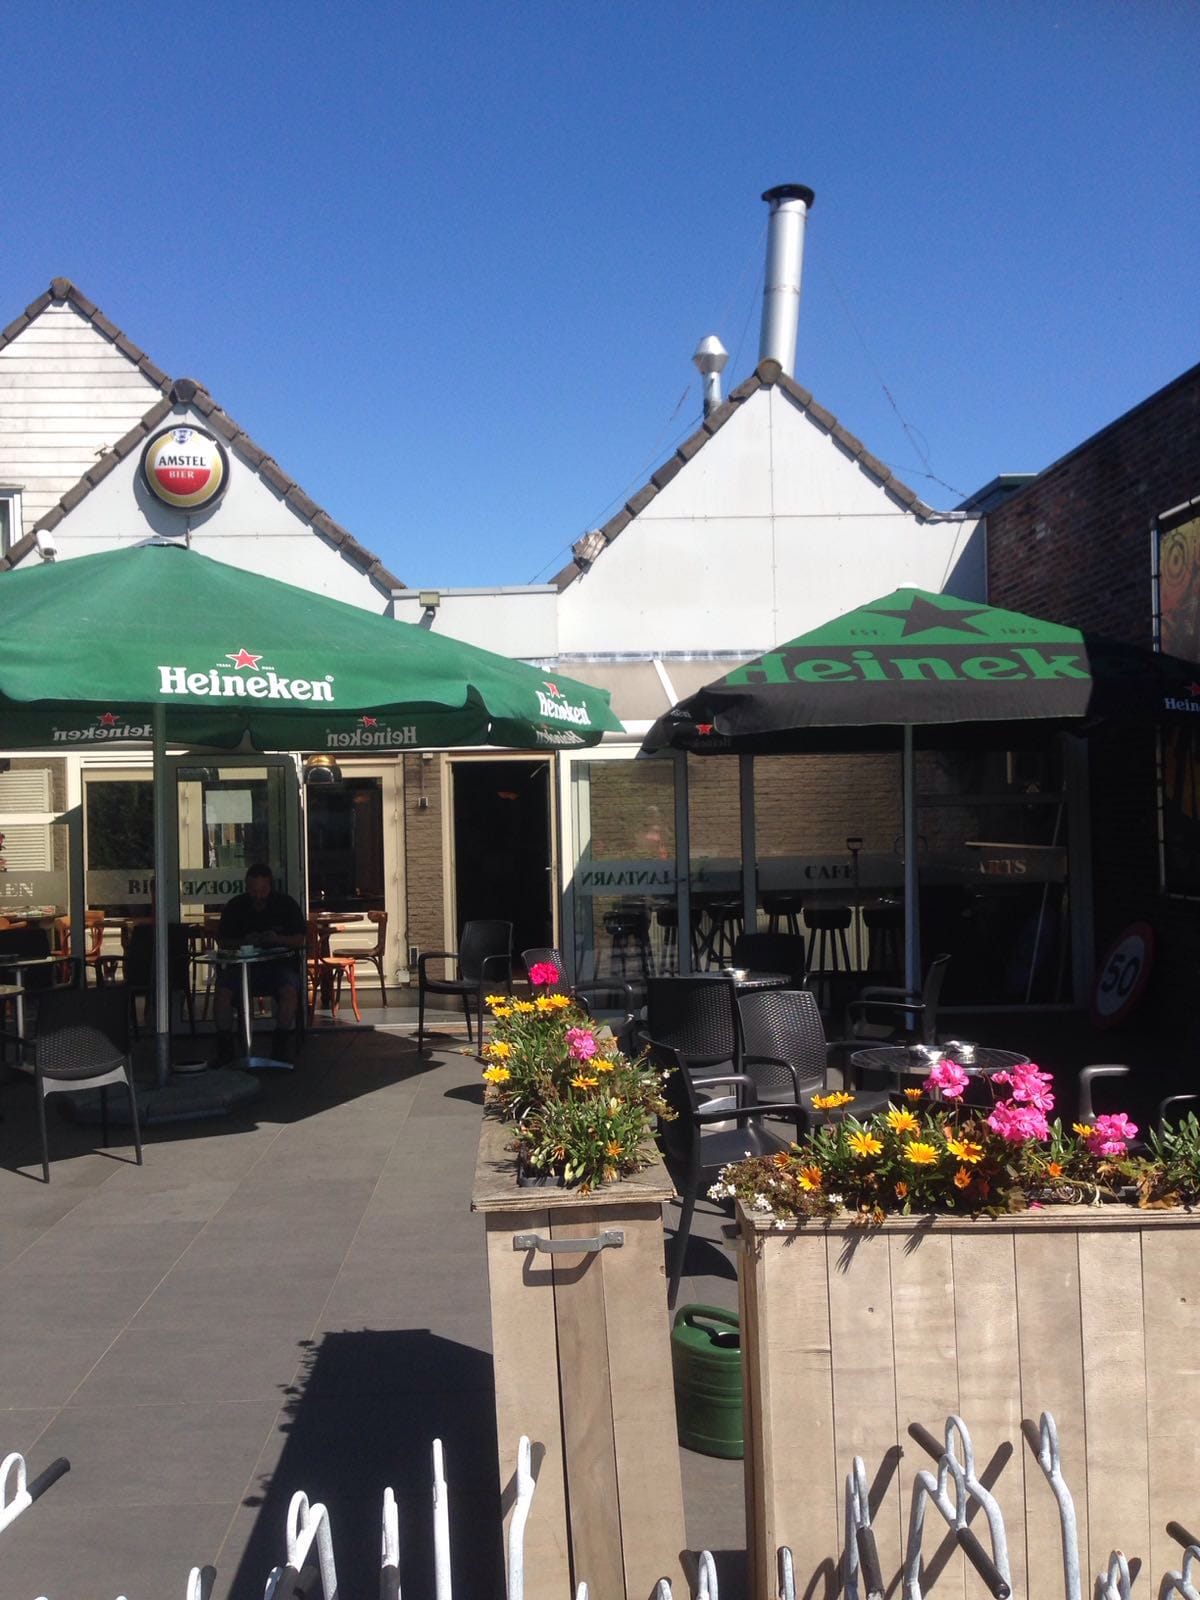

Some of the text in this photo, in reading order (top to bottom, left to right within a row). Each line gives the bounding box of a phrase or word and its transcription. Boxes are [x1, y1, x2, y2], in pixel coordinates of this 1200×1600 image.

[158, 455, 206, 467] AMSTEL
[168, 470, 195, 479] BIER
[157, 666, 334, 702] Heineken
[1101, 953, 1141, 997] 50
